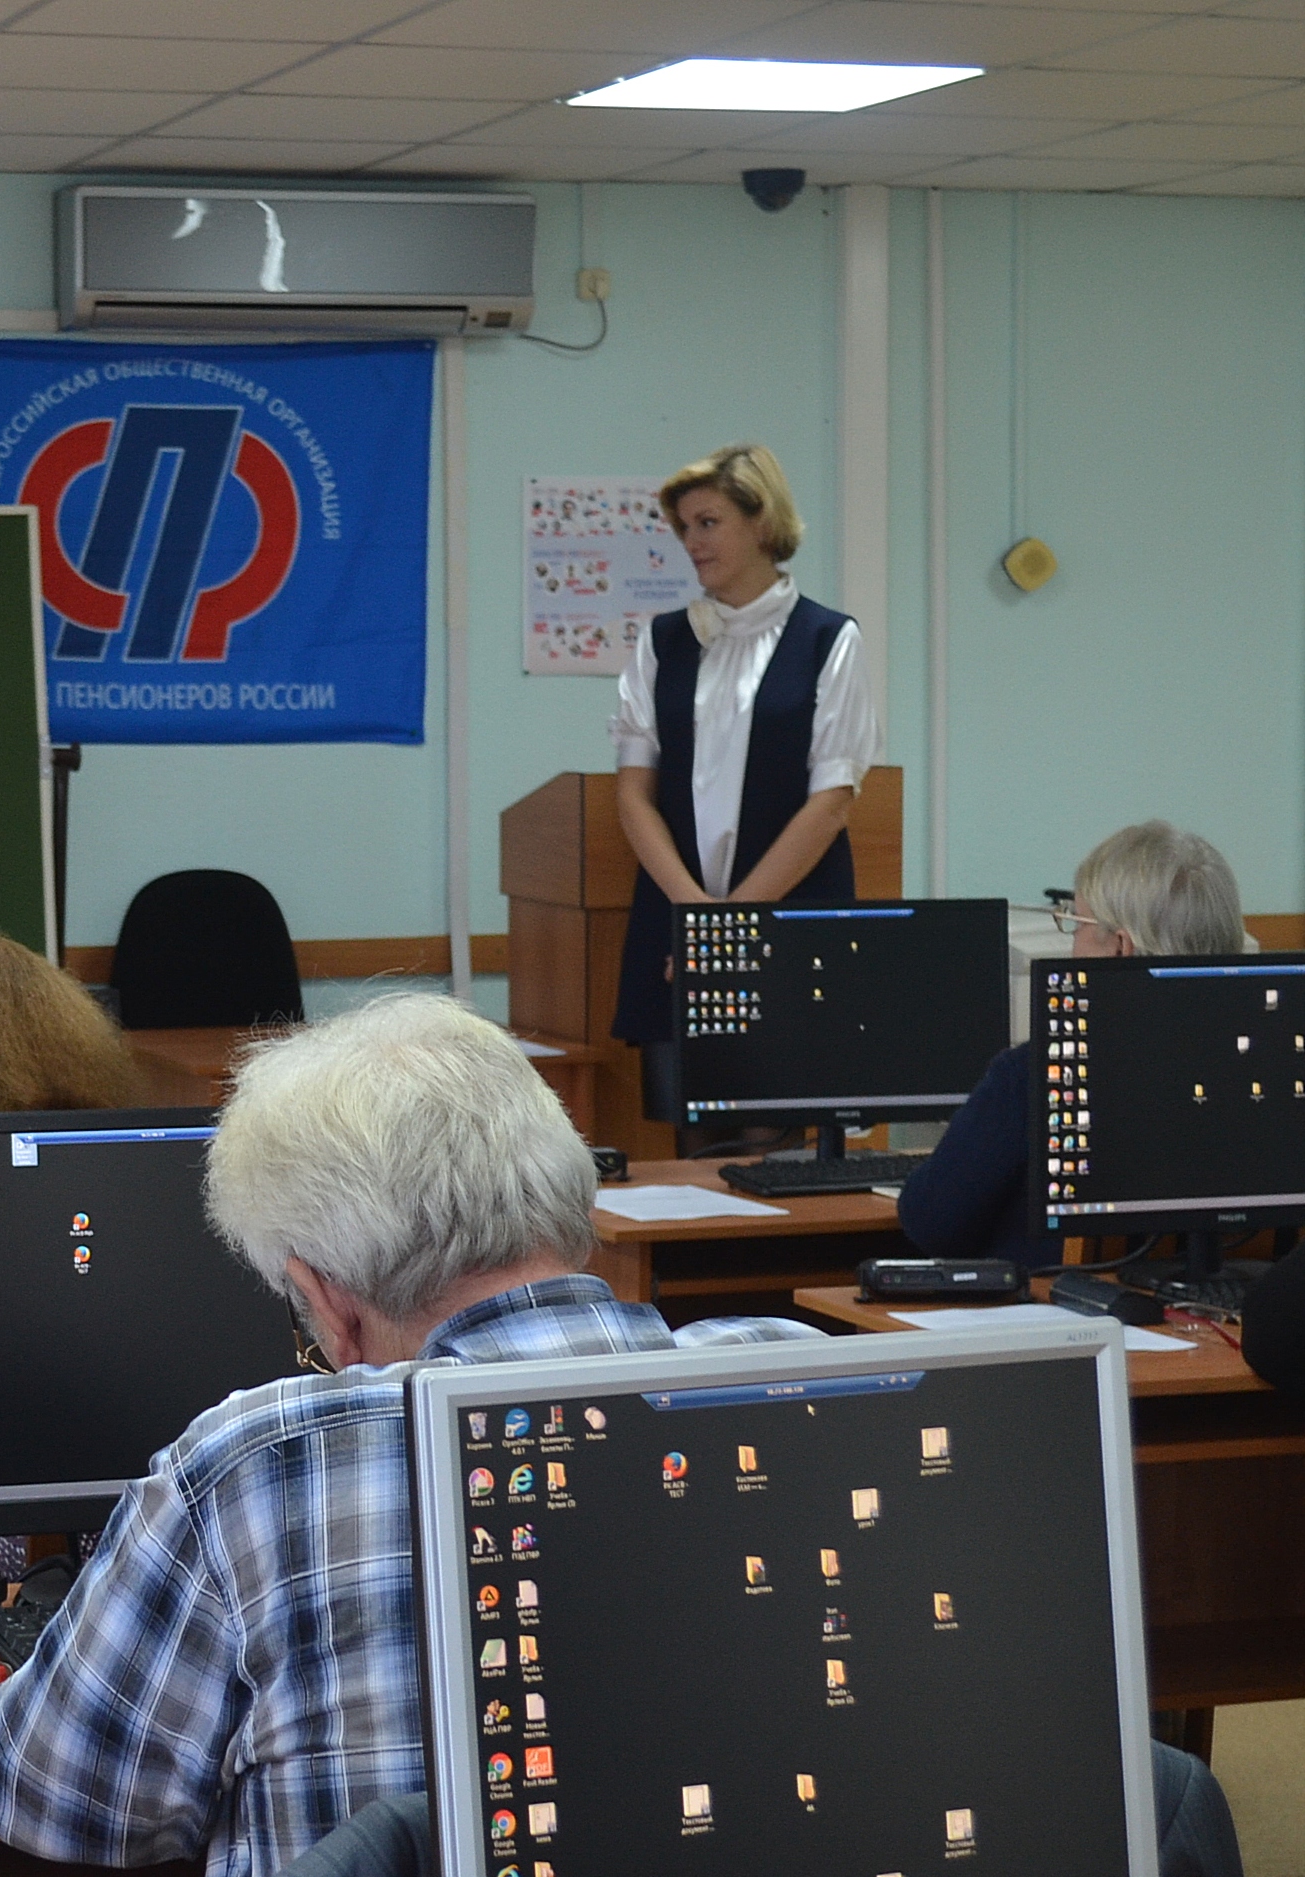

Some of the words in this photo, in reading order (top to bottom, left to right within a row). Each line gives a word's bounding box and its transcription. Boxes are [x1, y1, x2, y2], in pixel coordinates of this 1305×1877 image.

[104, 358, 269, 404] ОБЩЕСТВЕННАЯ
[267, 397, 341, 540] ОРГАНИЗАЦИЯ
[56, 682, 233, 710] ПЕНСИОНЕРОВ
[239, 683, 335, 711] РОССИИ
[490, 1782, 511, 1792] Google
[490, 1791, 514, 1801] Chrome
[493, 1839, 515, 1849] Google
[493, 1848, 517, 1858] Chrome
